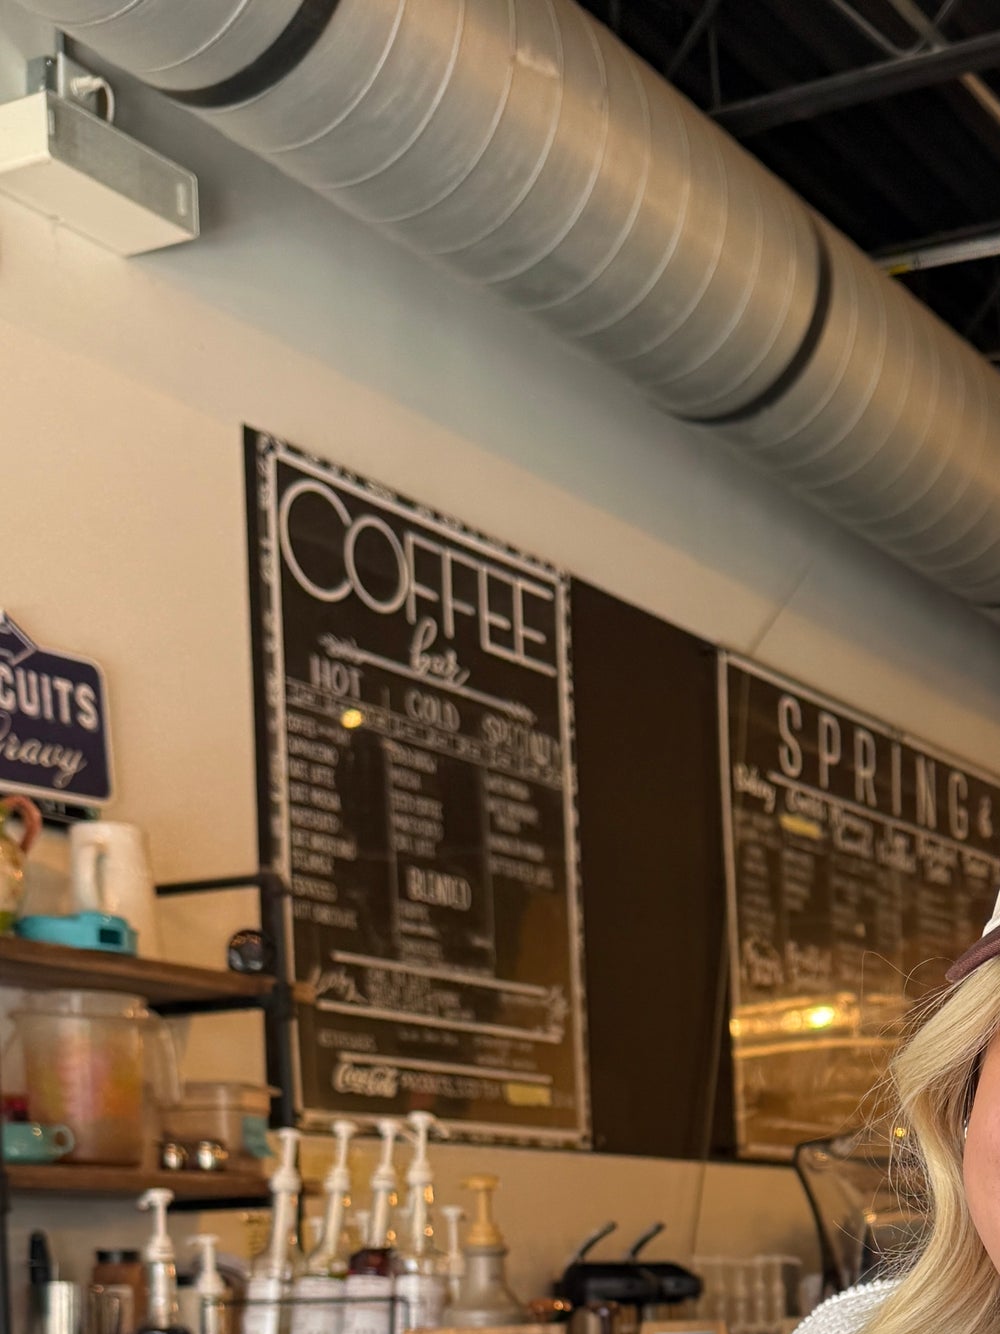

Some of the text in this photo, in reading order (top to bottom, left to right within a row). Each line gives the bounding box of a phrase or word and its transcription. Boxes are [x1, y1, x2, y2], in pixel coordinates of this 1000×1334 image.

[280, 479, 557, 677] COFFEE
[309, 652, 364, 699] HOT
[0, 712, 88, 788] ravy
[778, 695, 969, 840] SPRING
